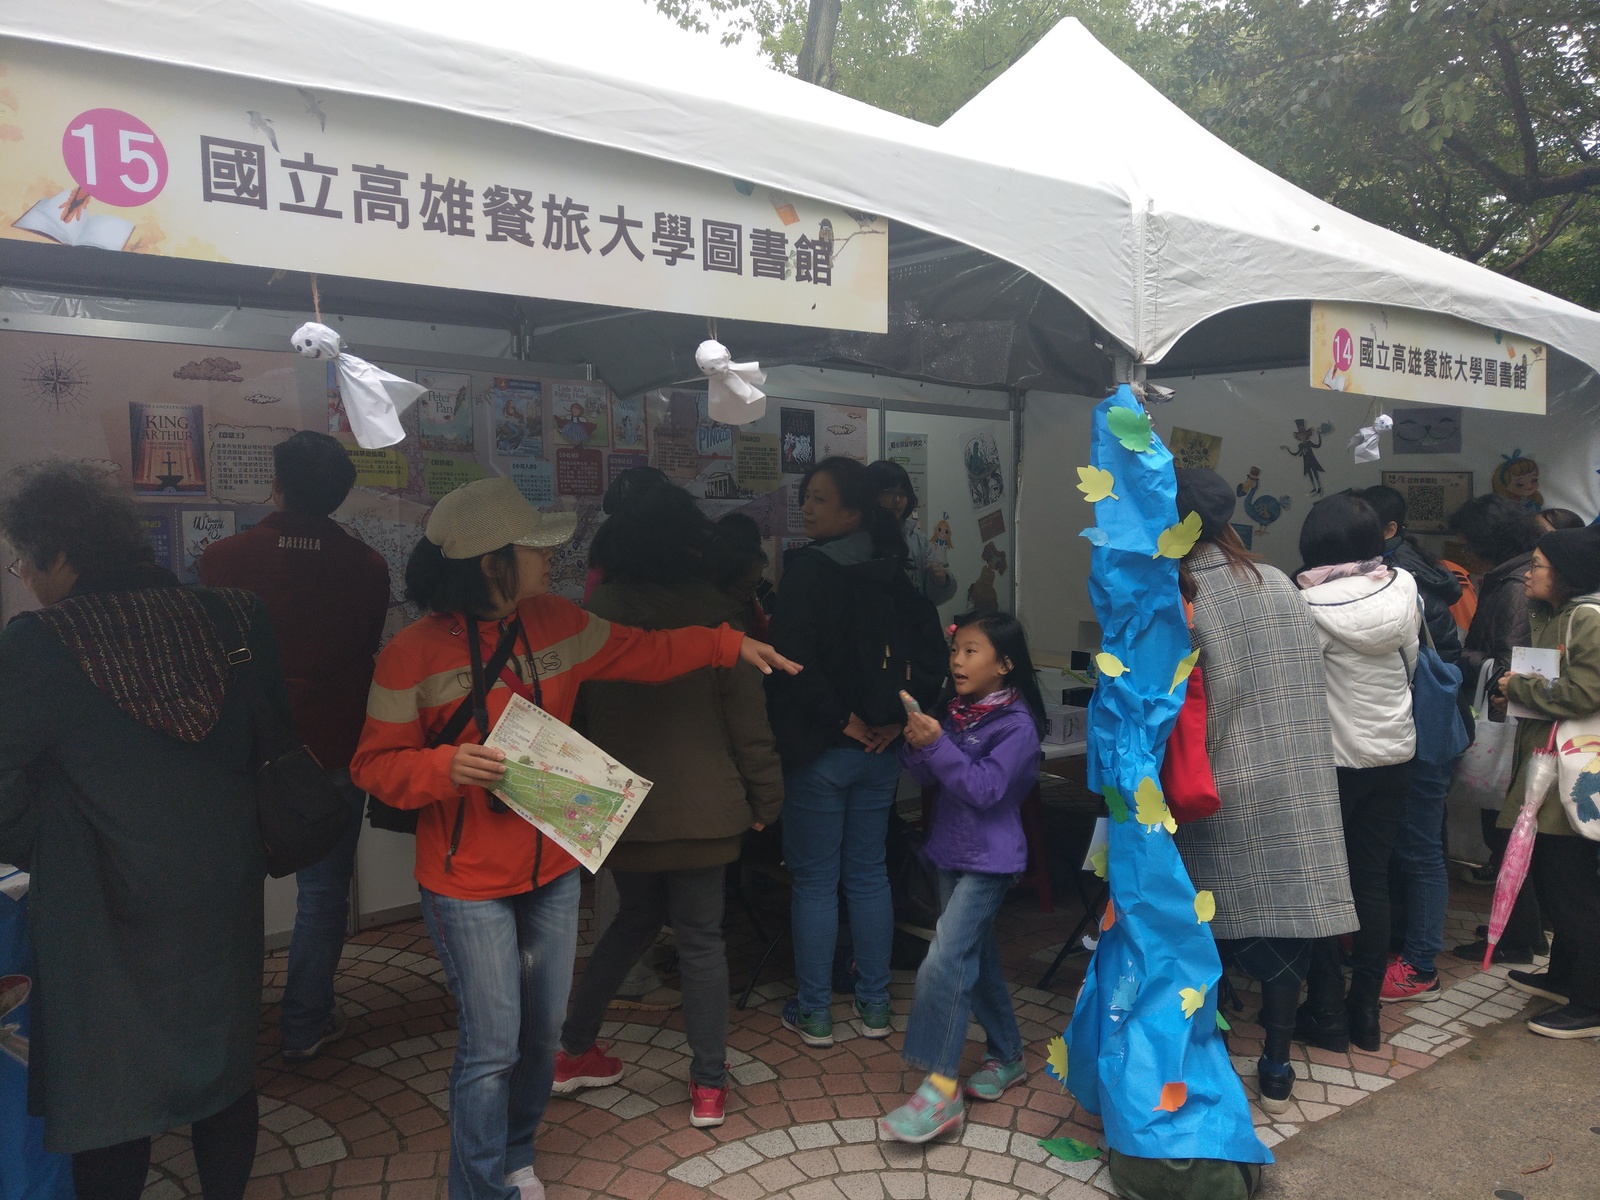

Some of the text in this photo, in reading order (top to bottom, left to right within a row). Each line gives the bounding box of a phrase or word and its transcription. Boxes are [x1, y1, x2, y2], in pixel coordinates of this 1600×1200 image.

[70, 123, 158, 193] 15
[199, 134, 832, 286] 國立高雄餐旅大學圖書館
[1334, 335, 1352, 365] 14
[1359, 336, 1527, 390] 國立高雄餐旅大學圖書館
[428, 390, 451, 403] Peter
[436, 402, 453, 413] Pan
[145, 415, 188, 431] KING
[142, 430, 193, 441] ARTHUR
